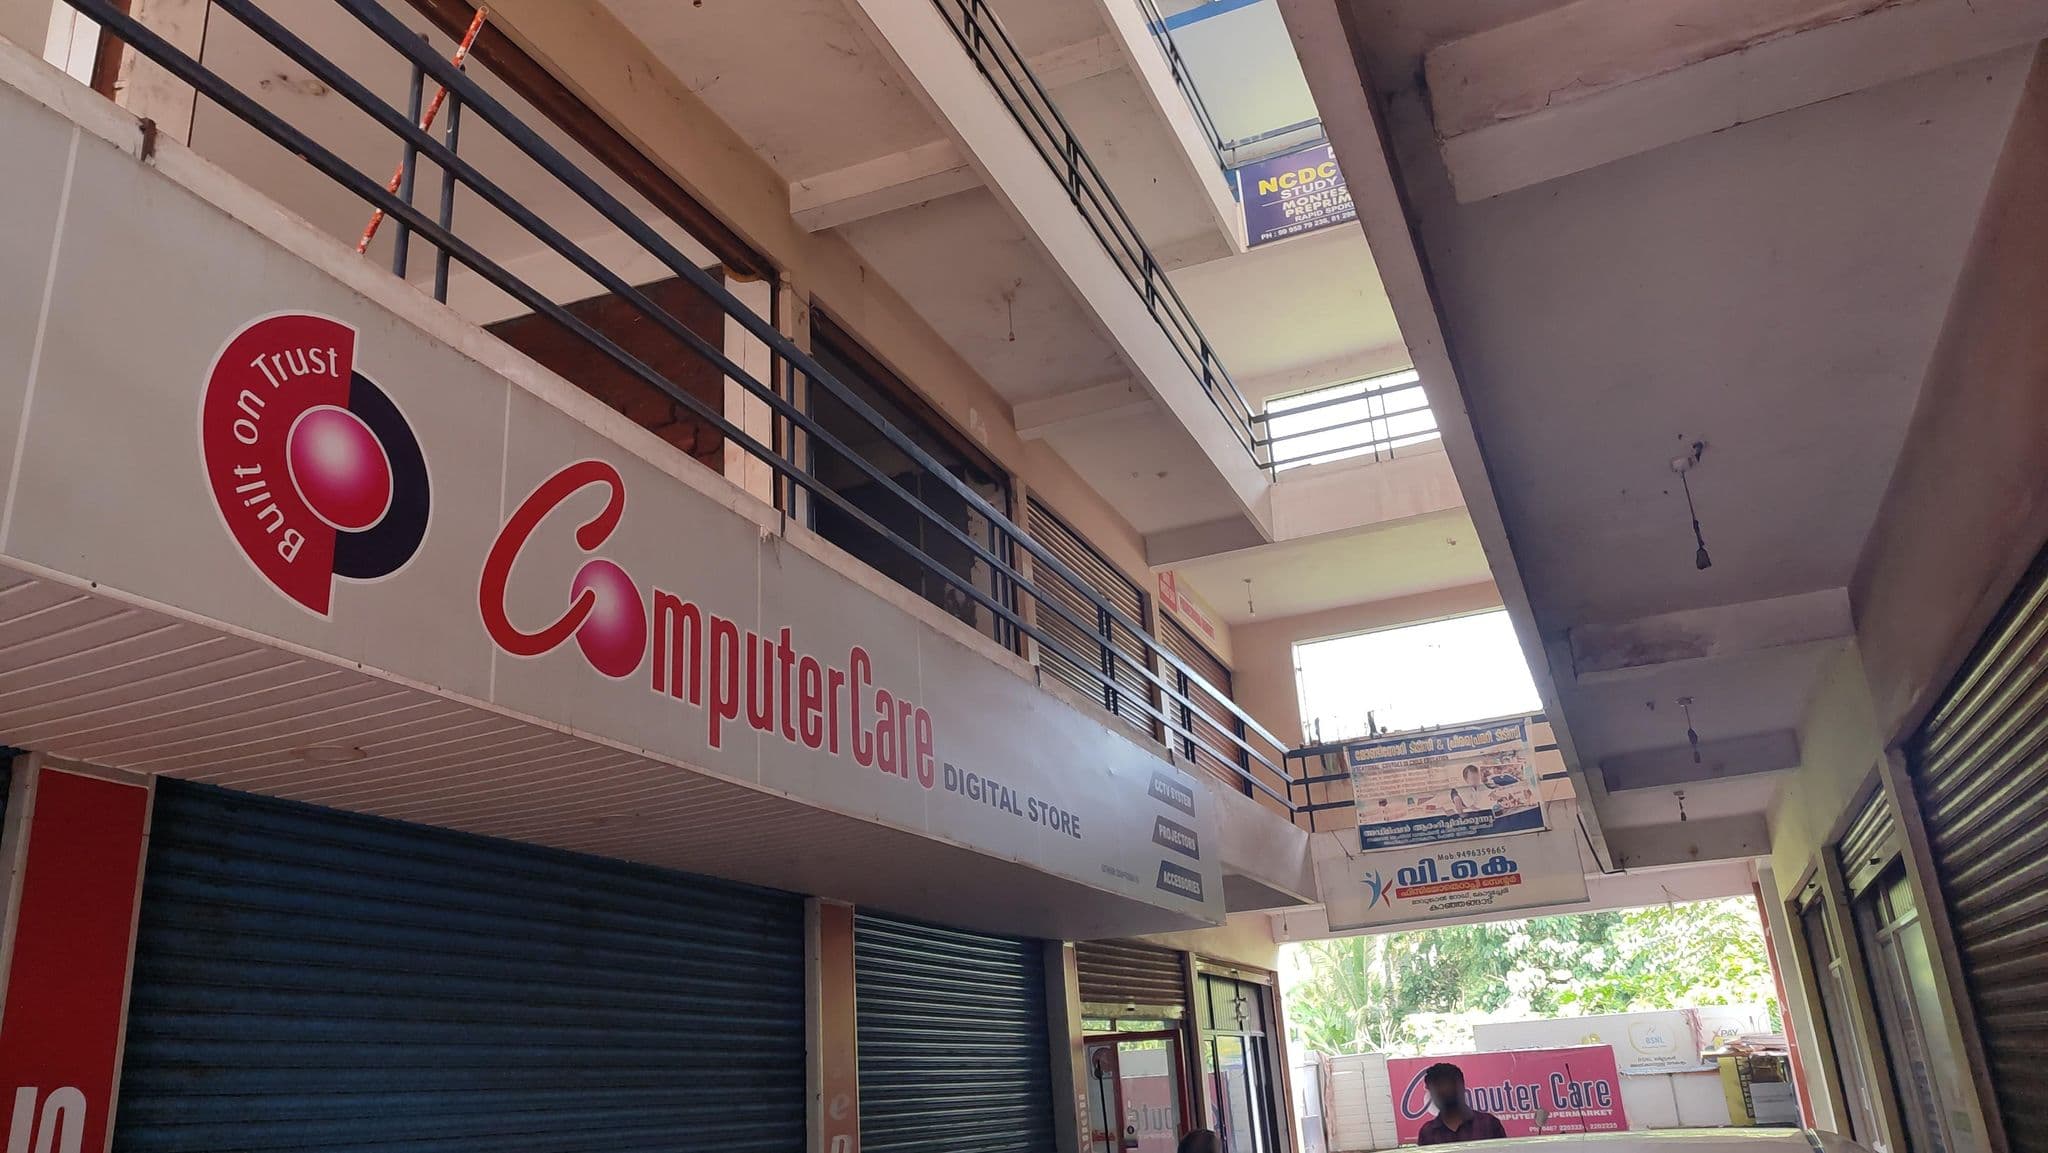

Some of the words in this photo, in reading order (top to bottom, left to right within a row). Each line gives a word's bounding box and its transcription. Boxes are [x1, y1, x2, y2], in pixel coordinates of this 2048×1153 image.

[1258, 161, 1337, 195] NCDC
[1280, 176, 1338, 199] STUDY
[1295, 209, 1323, 222] RAPID
[250, 346, 339, 388] Trust
[233, 389, 266, 445] on
[233, 462, 306, 564] Built
[1436, 740, 1444, 750] &
[943, 762, 1023, 817] DIGITAL
[1028, 796, 1082, 840] STORE
[1154, 778, 1171, 797] CCTV
[1549, 1072, 1612, 1110] Care
